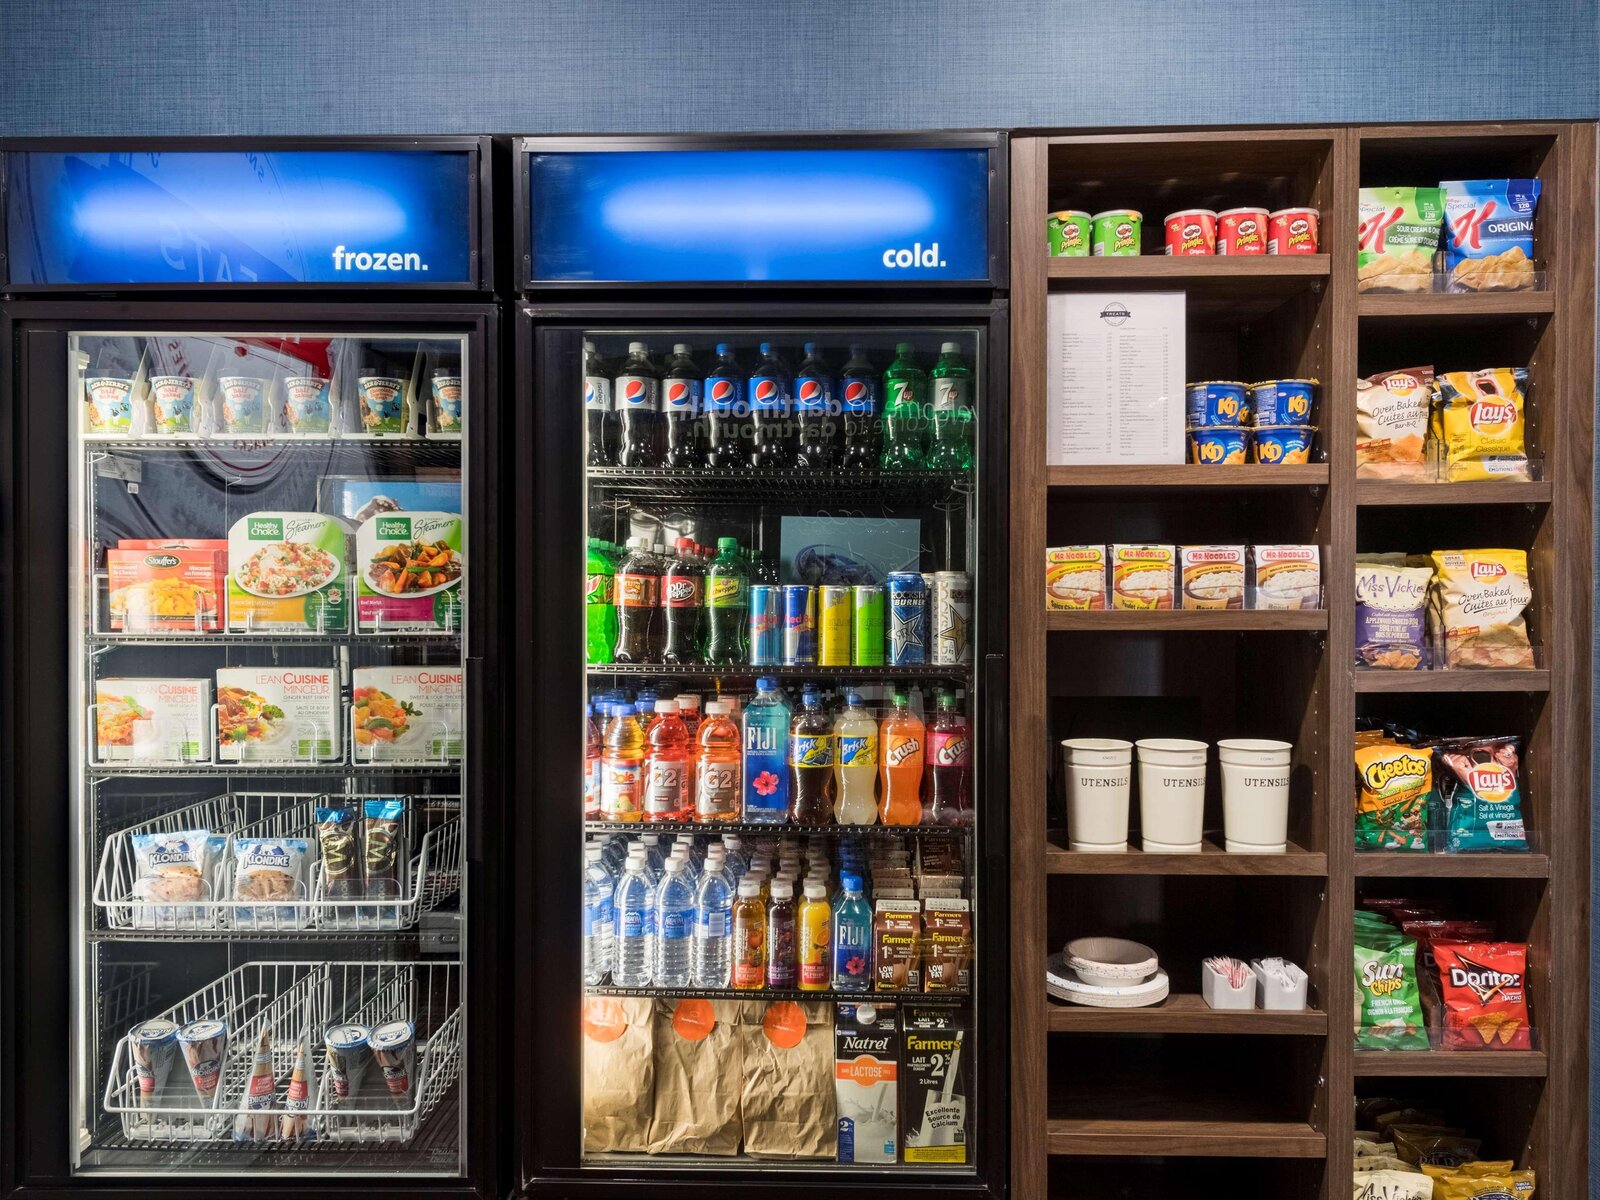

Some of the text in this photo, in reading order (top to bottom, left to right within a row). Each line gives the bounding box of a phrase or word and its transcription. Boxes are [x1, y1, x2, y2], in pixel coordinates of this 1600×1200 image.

[1448, 202, 1477, 212] Special
[1450, 201, 1497, 249] K
[1488, 221, 1533, 234] ORIGINA
[1060, 237, 1083, 253] Pringles
[1114, 237, 1136, 253] Pringles
[1181, 237, 1204, 253] Pringles
[1236, 233, 1259, 250] Pringles
[1288, 233, 1311, 249] Pringles
[332, 245, 429, 271] frozen.
[882, 242, 946, 269] cold.
[1385, 377, 1416, 390] Lay's
[1217, 396, 1239, 419] KD
[1288, 394, 1309, 418] KD
[1372, 404, 1395, 418] Oven
[1473, 401, 1515, 425] Lay's
[1480, 437, 1506, 445] Classic
[1200, 441, 1225, 464] KD
[1259, 440, 1283, 463] KD
[1476, 445, 1511, 455] Classique
[254, 521, 279, 531] Healthy
[286, 519, 328, 541] Steamers
[382, 521, 408, 531] Healthy
[413, 519, 455, 541] Steamers
[250, 528, 281, 538] Choice
[379, 528, 410, 538] Choice
[1065, 551, 1096, 561] NOODLES
[1135, 549, 1166, 559] NOODLES
[1203, 551, 1236, 561] NOODLES
[1277, 551, 1310, 560] NOODLES
[148, 556, 177, 567] Stouffer's
[1473, 563, 1504, 577] Lay's
[1356, 574, 1384, 598] Miss
[1458, 584, 1513, 606] Oven Baked
[1463, 594, 1529, 615] Cuites au four
[256, 672, 329, 685] LEAN CUISINE
[391, 672, 464, 685] LEAN CUISINE
[159, 684, 199, 695] CUISINE
[283, 685, 329, 695] MINCEUR
[747, 726, 777, 750] FIJI
[886, 738, 920, 766] Crush
[610, 771, 636, 783] Dole
[653, 768, 678, 788] G2
[1366, 755, 1427, 790] Cheetos
[704, 769, 733, 790] G2
[1080, 777, 1128, 788] UTENSILS
[1473, 770, 1512, 795] Lay's
[1478, 804, 1489, 812] Salt
[1478, 812, 1488, 820] Sel
[243, 853, 290, 869] KLONDIKE
[885, 912, 913, 920] Farmers
[839, 926, 865, 945] FIJI
[882, 934, 916, 945] Farmers
[878, 965, 894, 974] LOW
[928, 964, 943, 973] LOW
[931, 970, 943, 979] FAT
[1361, 961, 1404, 987] Sun
[881, 971, 894, 980] FAT
[1451, 967, 1521, 988] Doritos
[877, 982, 898, 990] Farmers
[927, 981, 947, 989] Farmers
[1370, 978, 1403, 997] Chips
[1371, 999, 1391, 1007] FRENCH
[843, 1036, 891, 1051] Natrel
[907, 1036, 962, 1051] Farmers
[912, 1056, 927, 1064] LAIT
[850, 1066, 882, 1079] LACTOSE
[924, 1078, 939, 1086] Litres
[925, 1107, 961, 1118] Excellente
[927, 1113, 961, 1124] Source de
[931, 1120, 959, 1130] Calcium
